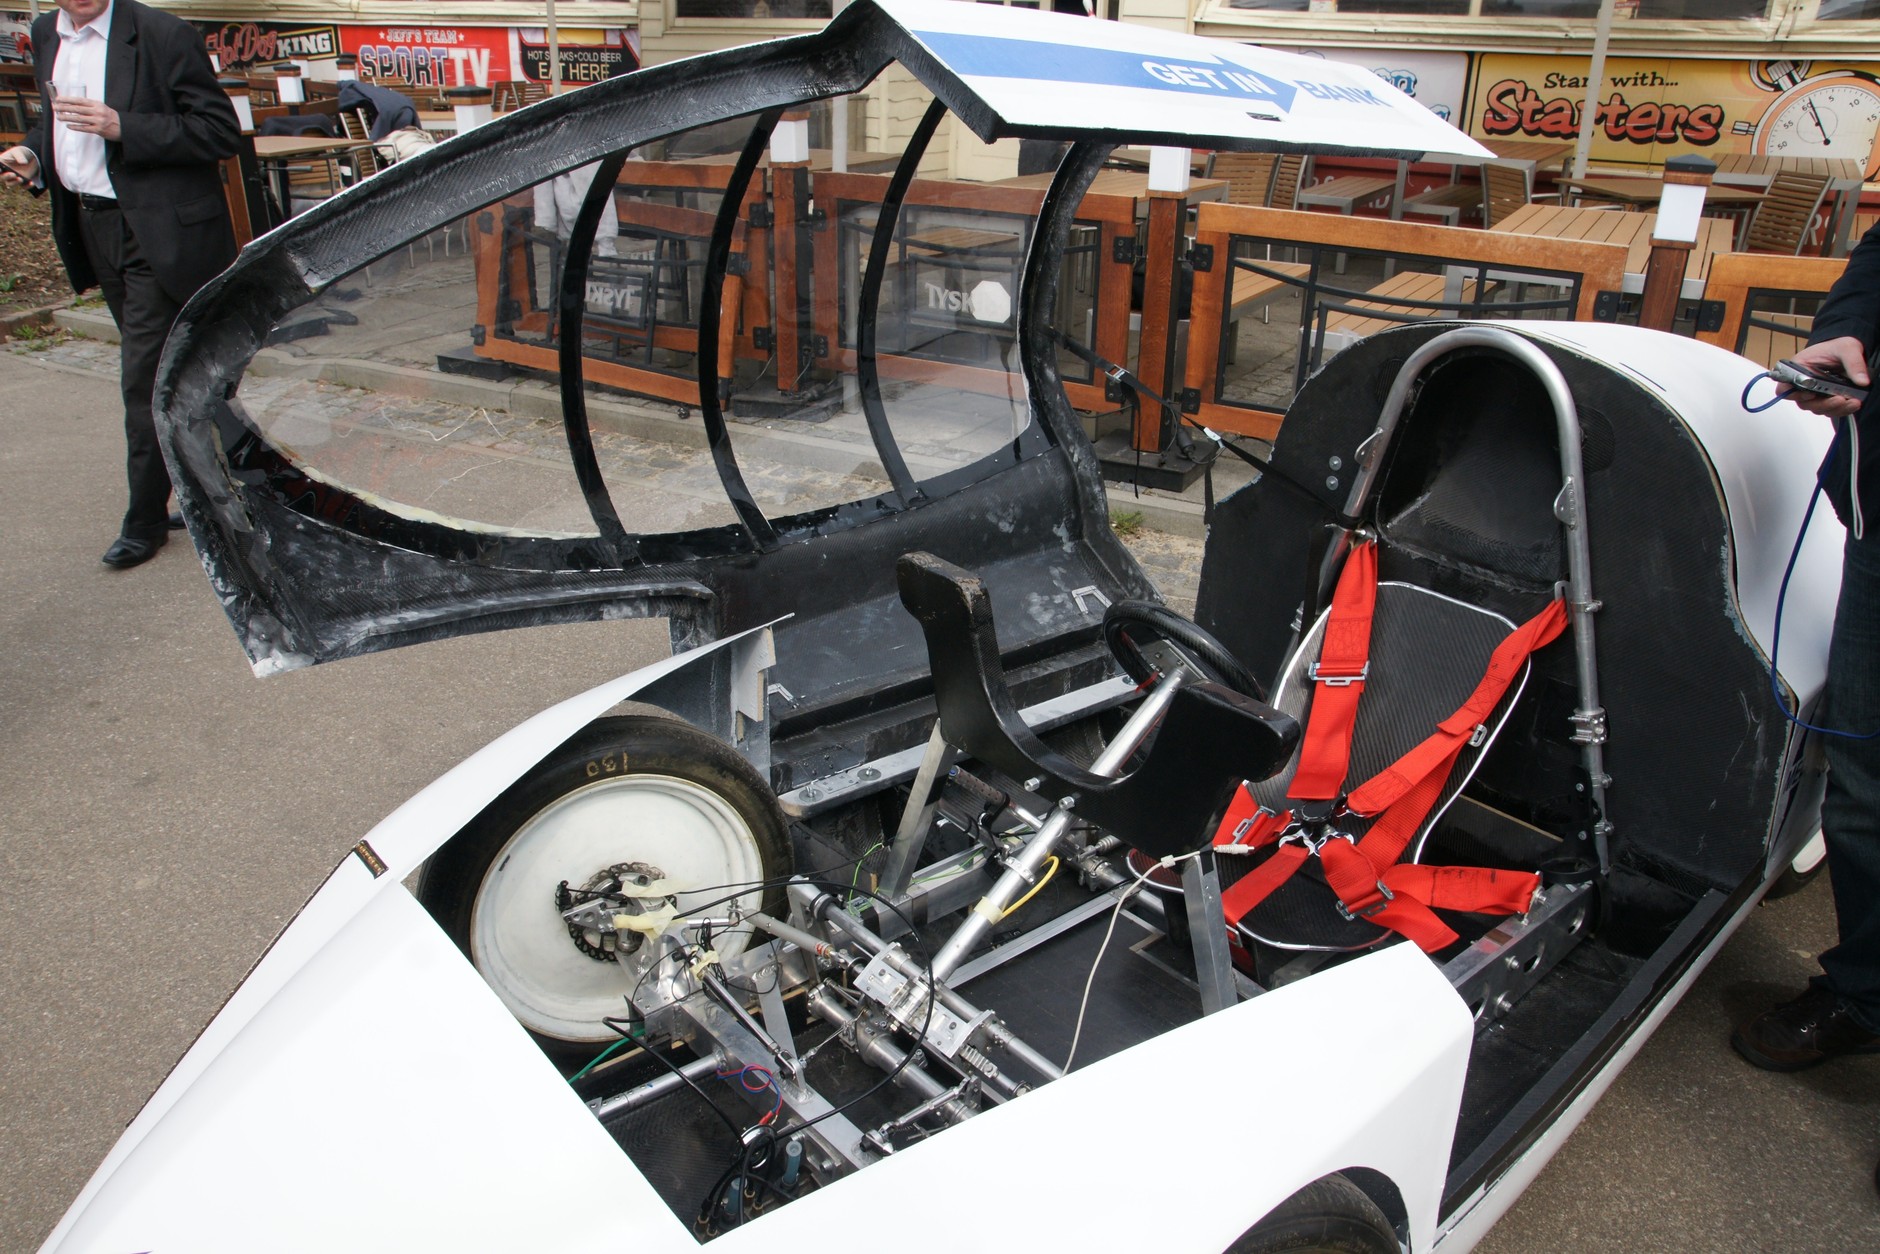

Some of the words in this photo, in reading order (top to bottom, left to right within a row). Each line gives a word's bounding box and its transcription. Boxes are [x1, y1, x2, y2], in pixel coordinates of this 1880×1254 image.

[240, 23, 278, 61] Dog
[277, 32, 332, 58] KING
[386, 28, 423, 43] JEFF'S
[425, 29, 457, 44] TEAM
[527, 50, 544, 60] HOT
[544, 51, 574, 61] SAKS
[577, 52, 599, 62] COLD
[600, 53, 622, 63] BEER
[359, 45, 448, 87] SPORT
[448, 47, 490, 88] TV
[569, 63, 610, 80] HERE
[1141, 61, 1229, 90] GET
[1222, 70, 1278, 95] IN
[1292, 79, 1394, 108] BANK
[1544, 72, 1603, 89] Star
[1848, 98, 1860, 108] 10
[1783, 120, 1794, 130] 55
[1866, 114, 1878, 123] 15
[1777, 140, 1788, 150] 50
[925, 282, 976, 314] TYSK
